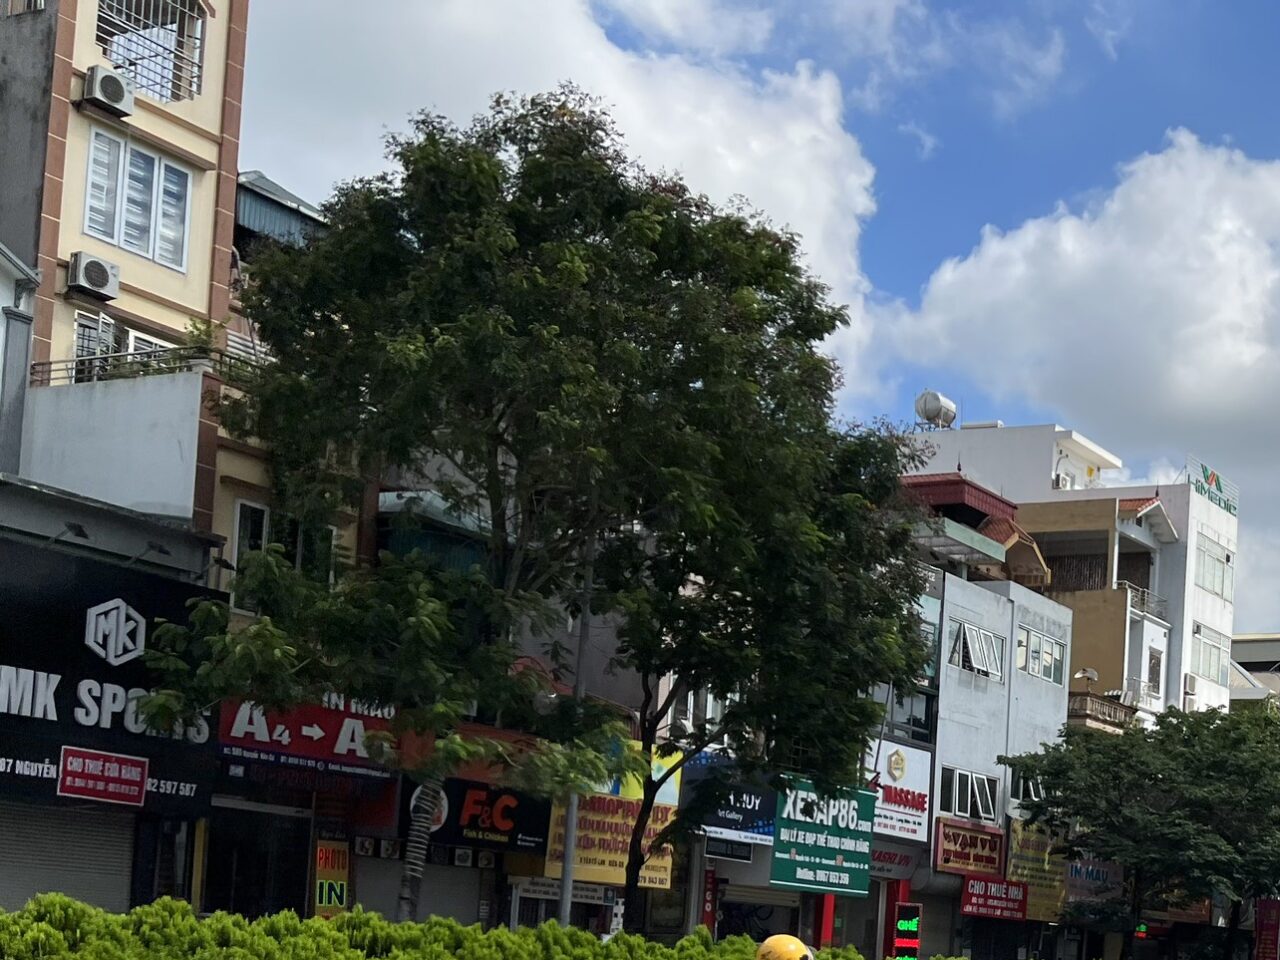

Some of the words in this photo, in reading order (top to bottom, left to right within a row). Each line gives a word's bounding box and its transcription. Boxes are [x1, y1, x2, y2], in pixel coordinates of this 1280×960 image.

[0, 664, 62, 721] MK
[74, 679, 210, 744] SPOS
[15, 758, 57, 779] NGUYỄN
[318, 847, 347, 870] PHOTO
[318, 880, 345, 906] IN
[968, 879, 985, 895] CHO
[987, 880, 1007, 898] THUÊ
